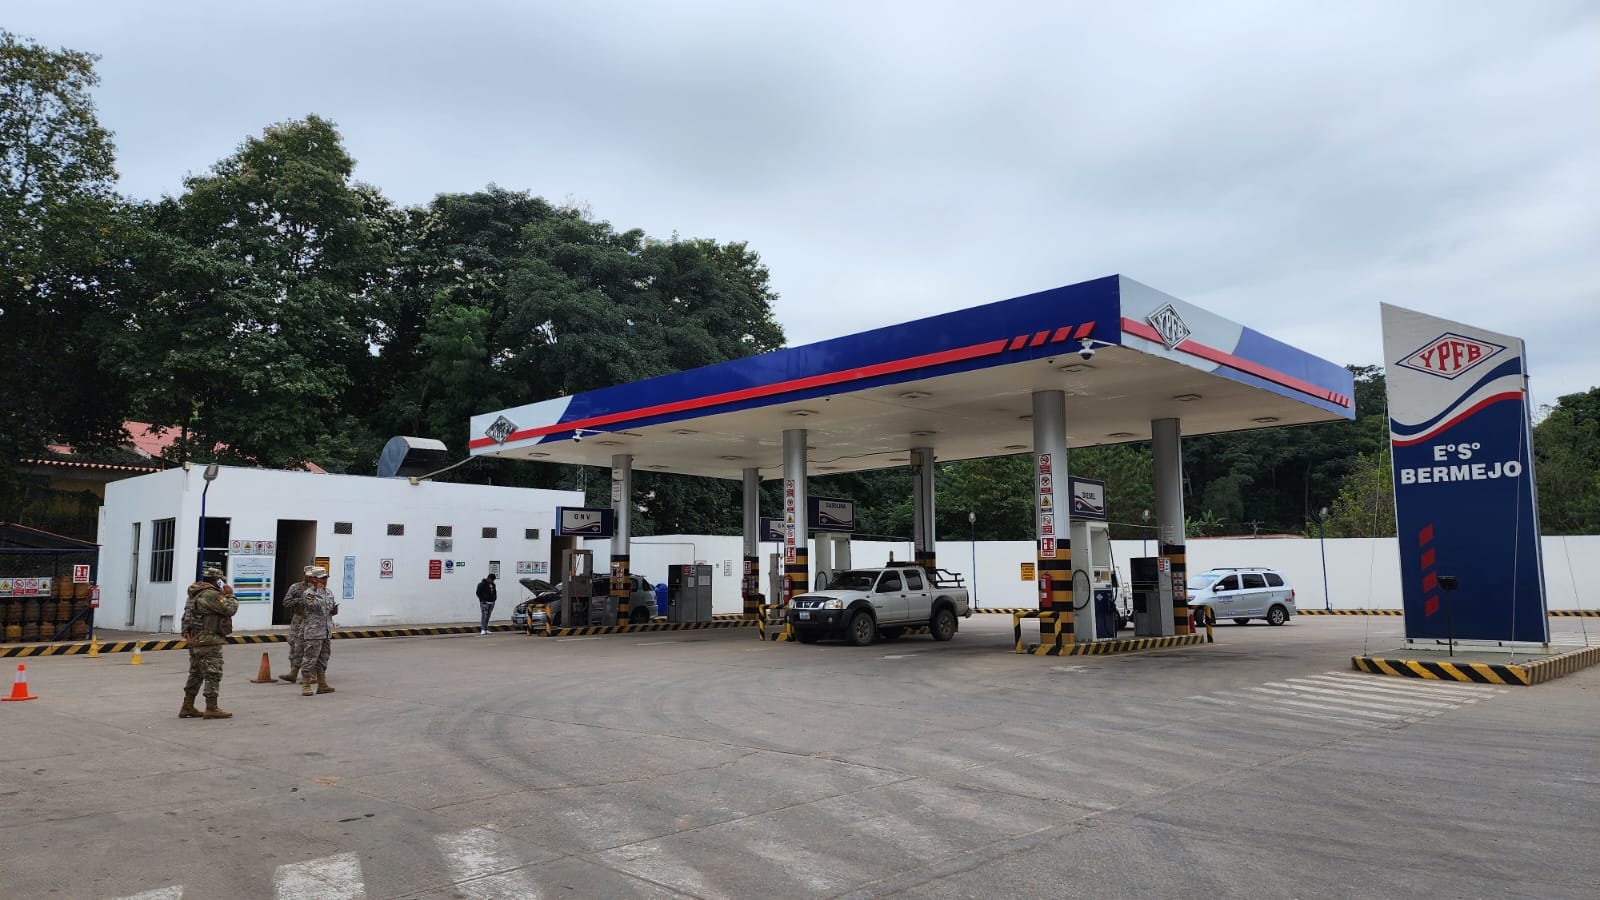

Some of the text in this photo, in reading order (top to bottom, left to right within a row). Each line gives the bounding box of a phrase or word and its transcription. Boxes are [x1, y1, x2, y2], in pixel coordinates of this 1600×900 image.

[1153, 310, 1185, 342] YPFB
[1419, 339, 1483, 373] YPFB
[1400, 460, 1522, 485] BERMEJO
